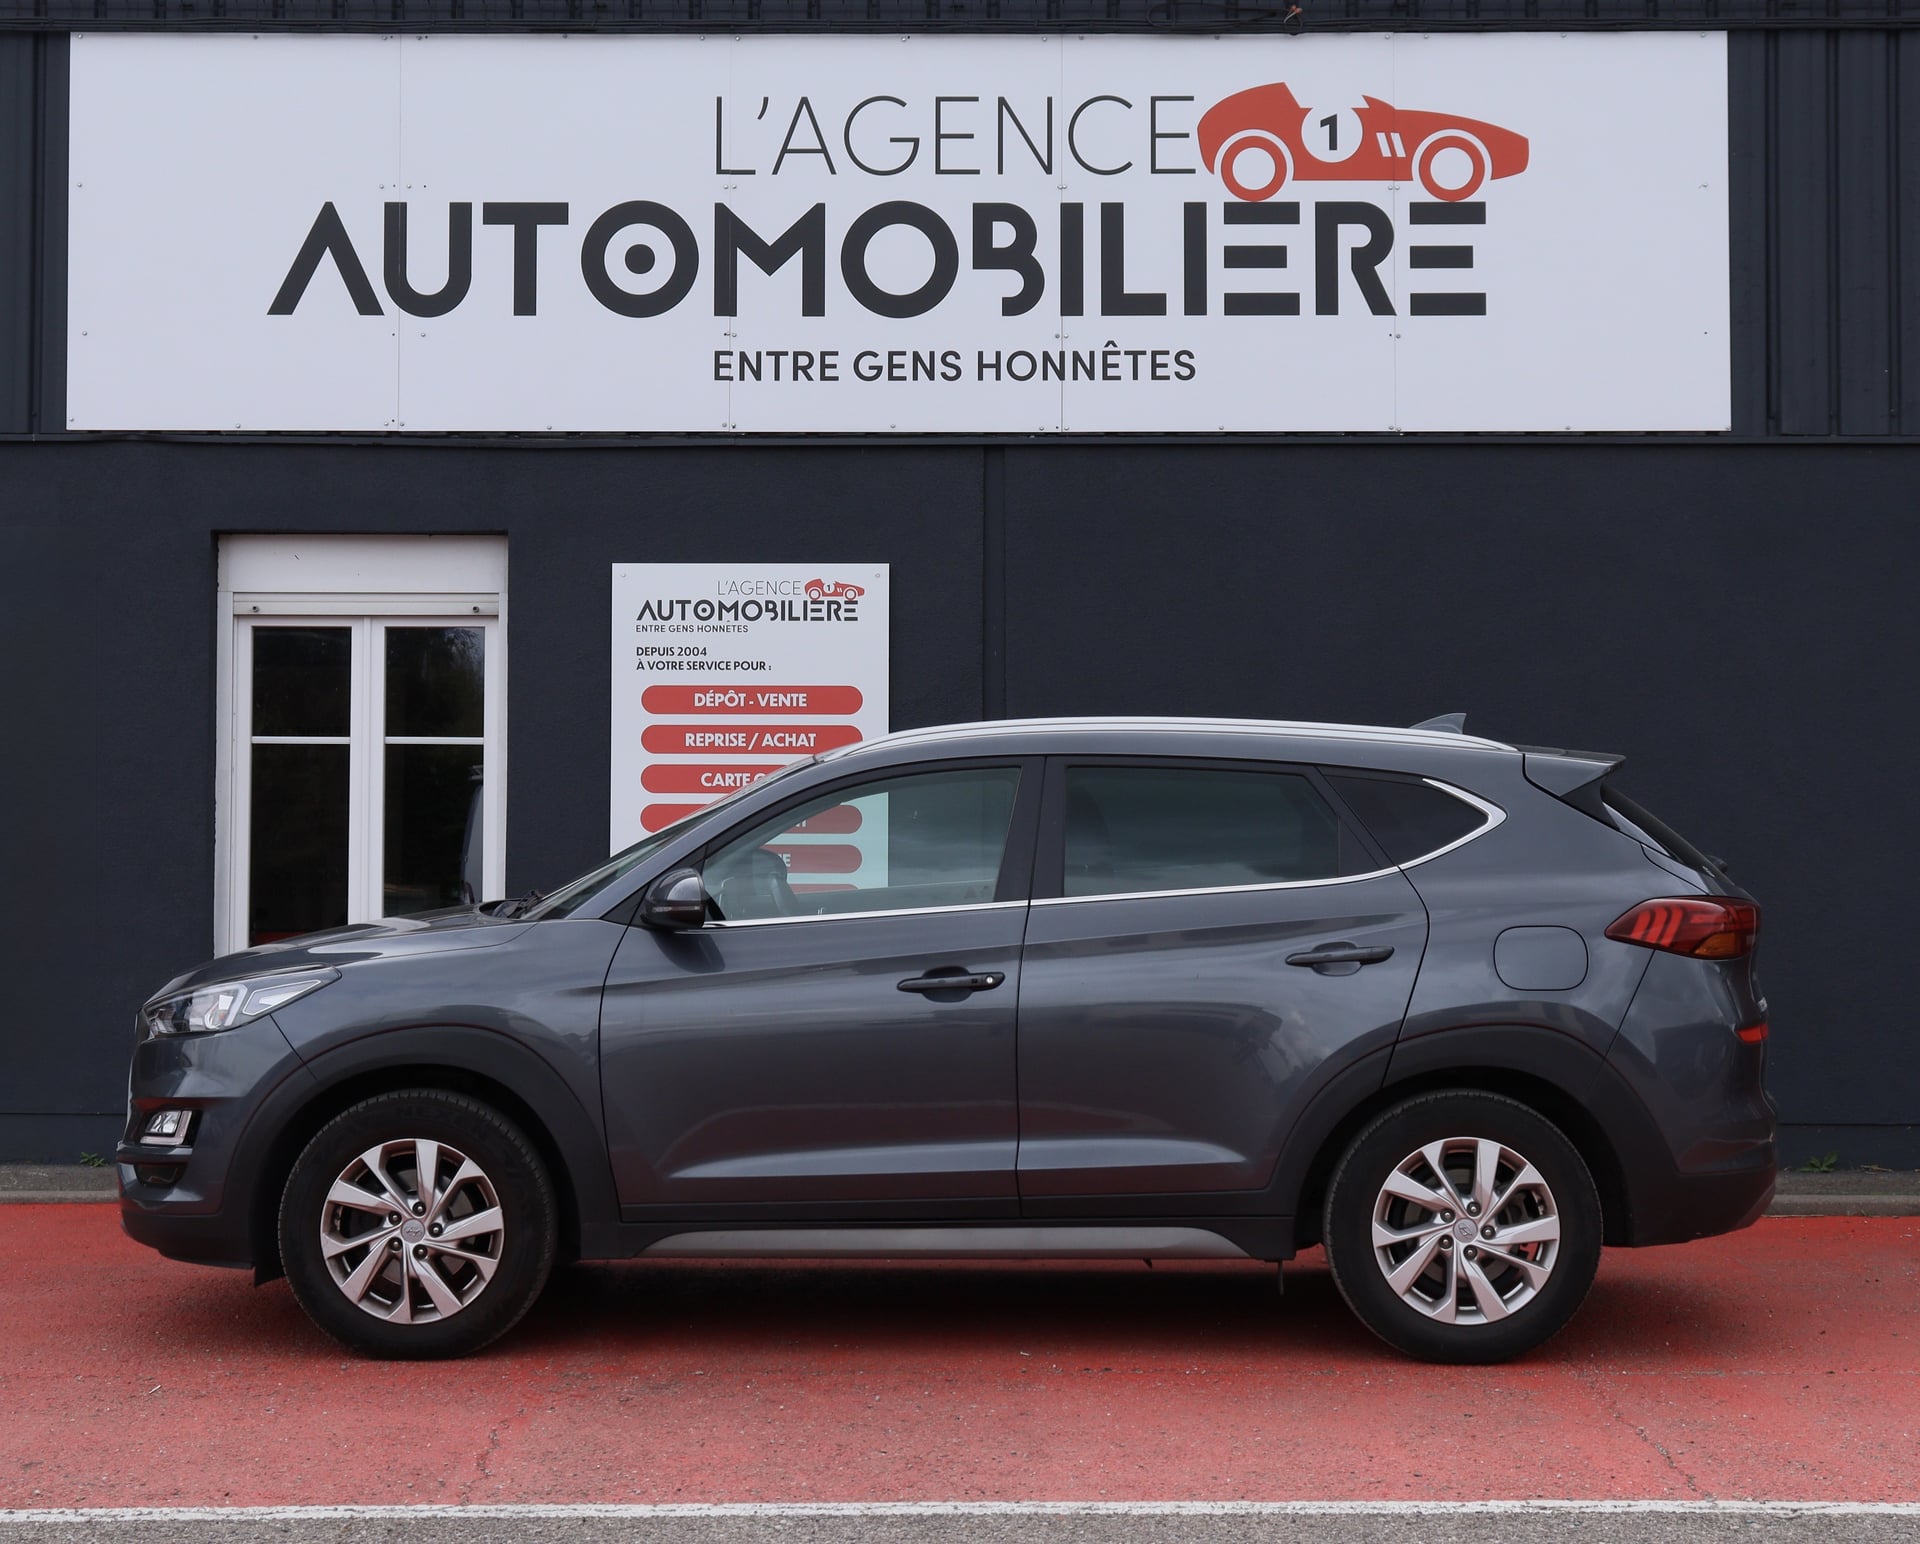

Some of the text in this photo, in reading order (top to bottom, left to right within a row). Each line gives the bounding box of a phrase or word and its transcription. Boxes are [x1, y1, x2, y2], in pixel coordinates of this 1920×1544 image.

[715, 95, 1196, 176] L'AGENCE
[1320, 113, 1338, 151] 1
[266, 199, 1487, 319] AUTOMOBILIERE
[714, 340, 1196, 382] ENTRE GENS HONNÊTES
[717, 580, 801, 596] L'AGENCE
[636, 600, 859, 622] AUTOMOBILIERE
[635, 624, 666, 633] ENTRE
[668, 624, 695, 633] GENS
[636, 646, 707, 657] DEPUIS 2004
[636, 658, 645, 671] À
[647, 660, 684, 671] VOTRE
[686, 660, 731, 671] SERVICE
[733, 660, 766, 671] POUR
[694, 690, 747, 707] DÉPÔT
[756, 693, 808, 707] VENTE
[685, 732, 817, 750] REPRISE / ACHAT
[700, 772, 751, 787] CARTE
